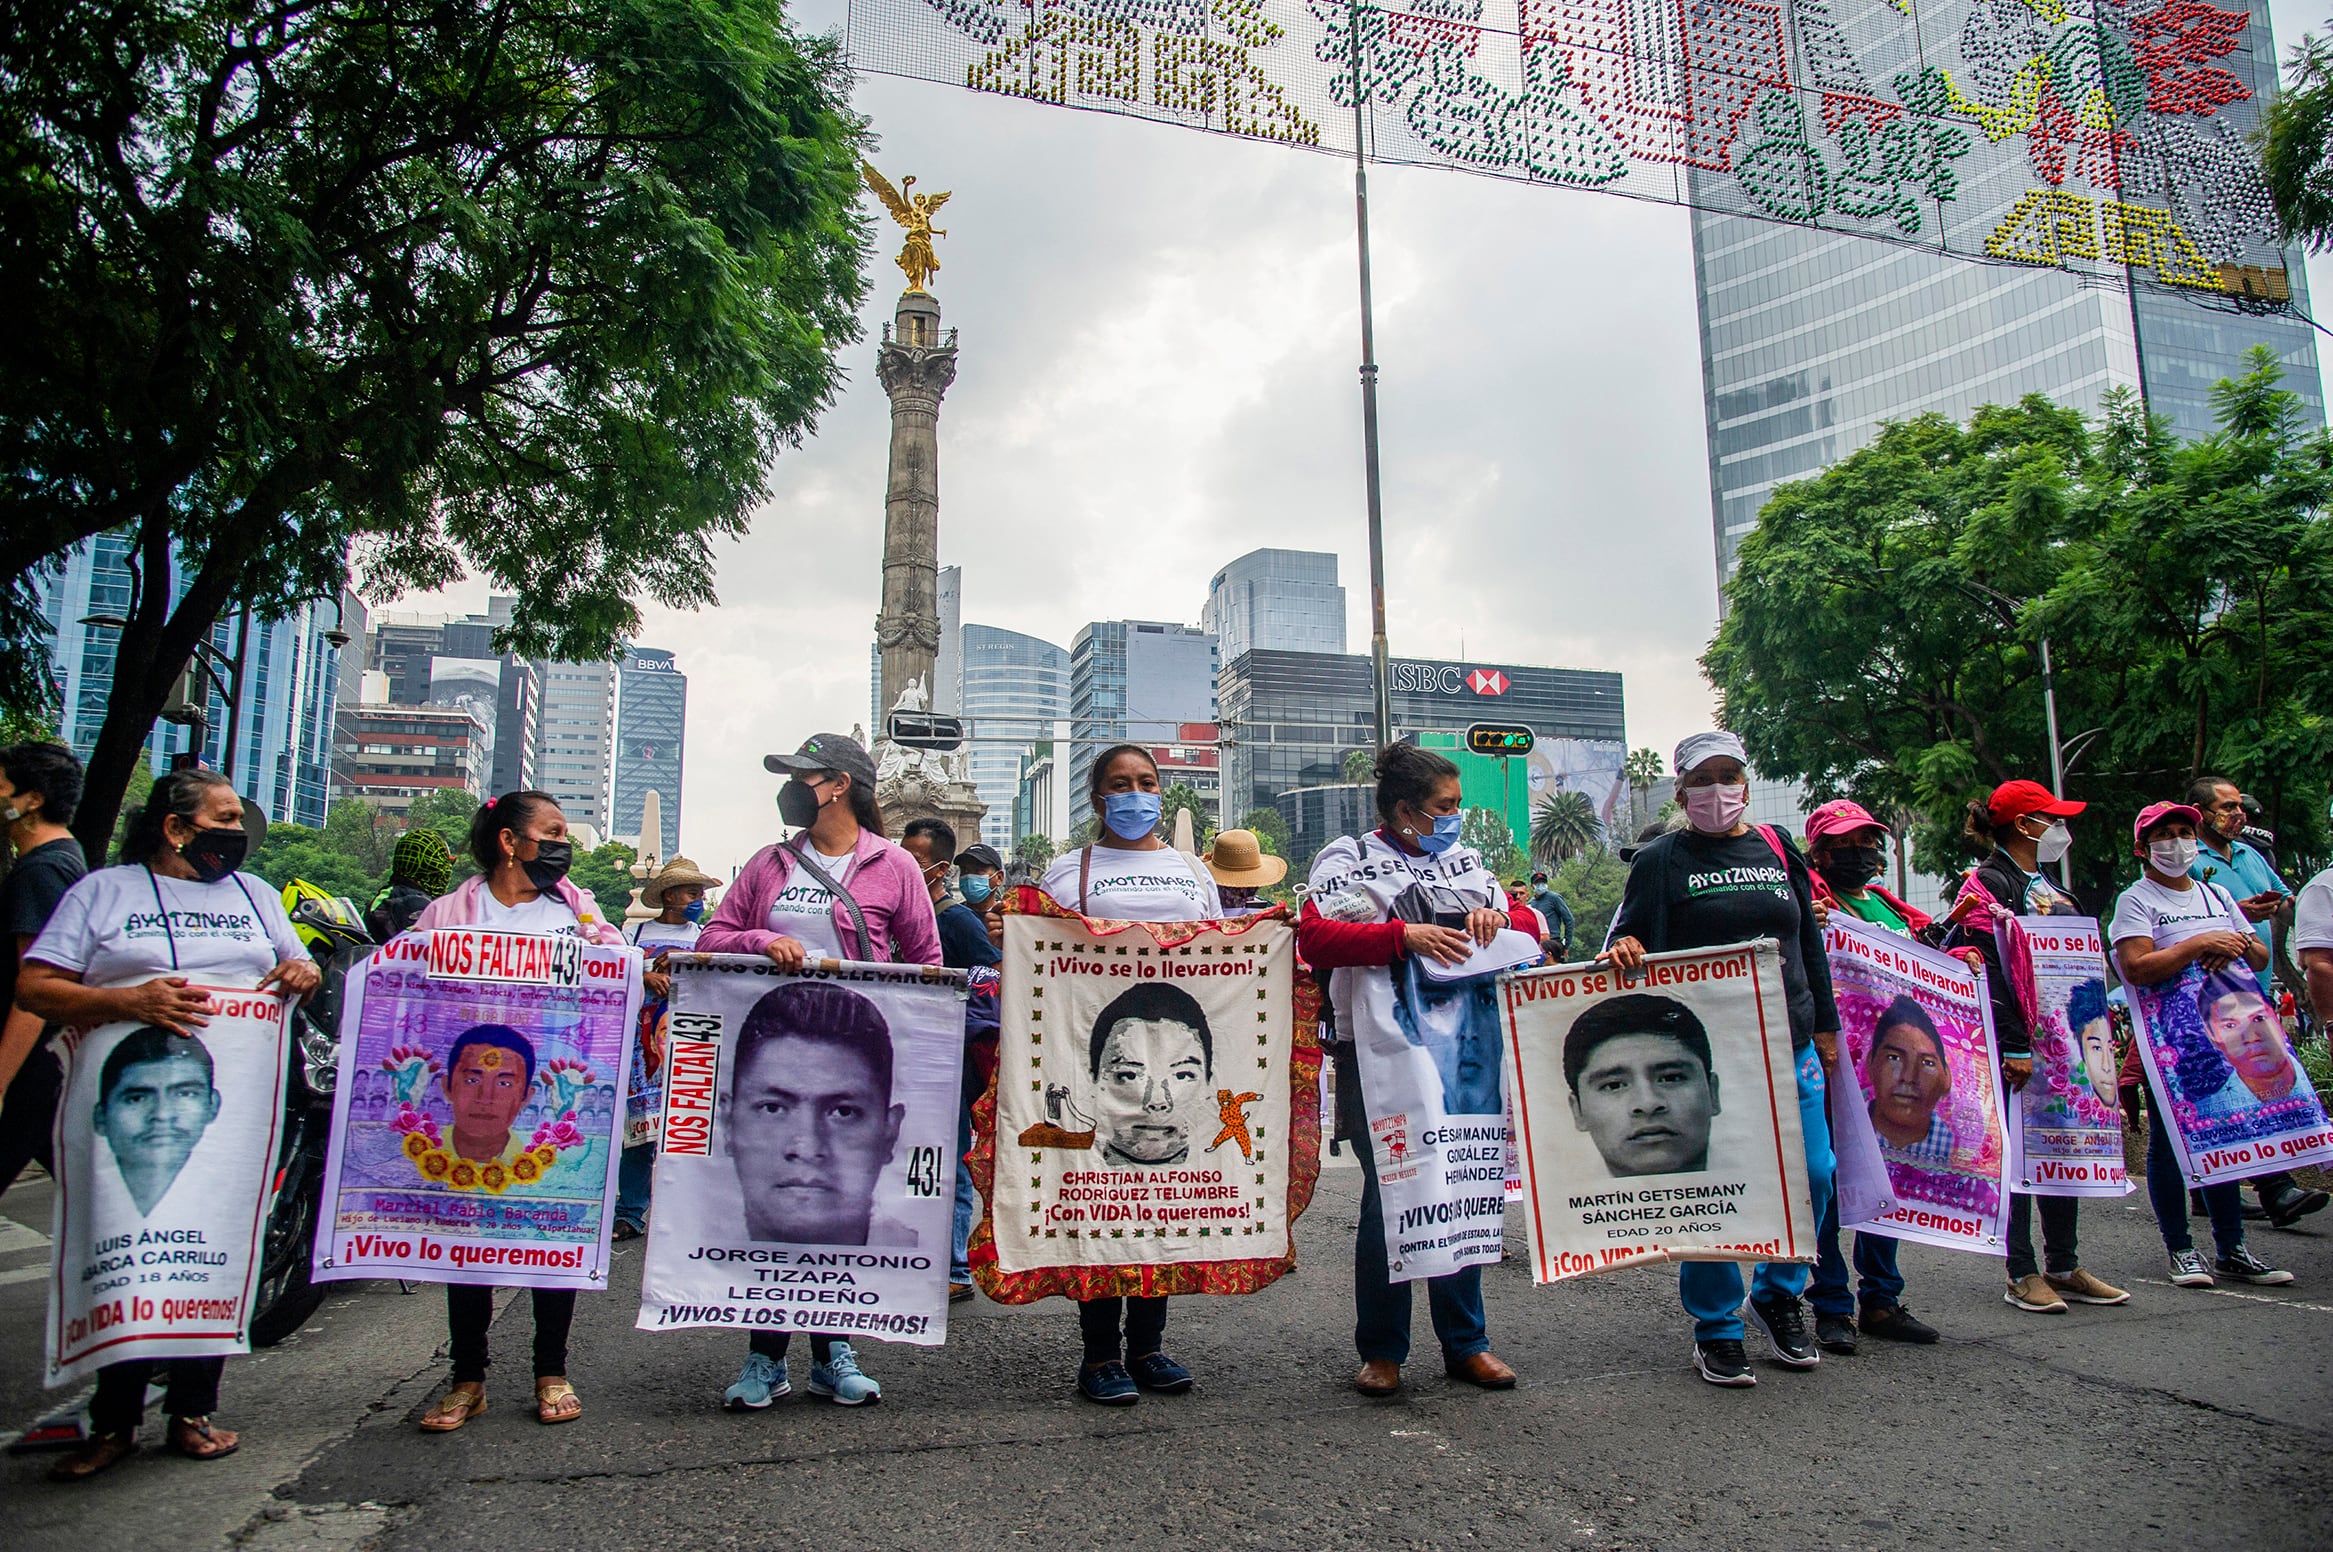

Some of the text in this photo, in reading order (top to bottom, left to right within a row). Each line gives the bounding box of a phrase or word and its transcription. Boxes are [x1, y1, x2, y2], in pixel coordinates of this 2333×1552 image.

[638, 659, 672, 670] BBVA
[1412, 867, 1437, 882] OS
[1740, 883, 1755, 891] con
[1774, 888, 1789, 900] 43
[127, 929, 185, 938] Caminado
[2064, 937, 2084, 951] se
[2088, 934, 2100, 953] lo
[429, 932, 583, 986] NOS FALTAN 43!
[1050, 957, 1253, 978] ¡Vivo se lo llevaron!
[1826, 929, 1870, 958] ¡Vivo
[1874, 948, 1891, 967] se
[1894, 953, 1908, 974] lo
[1912, 960, 1976, 999] llevaron!
[1514, 977, 1576, 1006] ¡Vivo
[1583, 974, 1607, 995] se
[1645, 955, 1749, 987] llevaron!
[212, 997, 280, 1024] varon!
[397, 1013, 428, 1034] 43
[558, 1025, 588, 1047] 43
[666, 1012, 722, 1155] NOS FALTAN 43!
[2042, 1135, 2077, 1145] JORGE
[2190, 1123, 2245, 1143] GIOVANNI
[2202, 1150, 2252, 1174] ¡Vivo
[2254, 1143, 2276, 1159] lo
[907, 1146, 942, 1197] 43!
[1063, 1170, 1222, 1184] CHRISTIAN ALFONSO
[2036, 1162, 2088, 1183] ¡Vivo
[2094, 1163, 2107, 1180] lo
[1059, 1186, 1239, 1200] RODRÍGUEZ TELUMBRE
[1569, 1183, 1747, 1208] MARTÍN GETSEMANY
[341, 1214, 363, 1224] Hijo
[384, 1215, 421, 1224] Luciano
[374, 1199, 568, 1221] Marcial Pablo Baranda
[1045, 1202, 1250, 1225] ¡Con VIDA lo queremos!
[1582, 1201, 1737, 1225] SÁNCHEZ GARCÍA
[1607, 1222, 1722, 1239] EDAD 20 AÑOS
[1874, 1207, 1983, 1237] ueremos!
[95, 1228, 207, 1255] LUIS ÁNGEL
[345, 1235, 584, 1268] ¡Vivo lo queremos!
[1400, 1239, 1435, 1255] CONTRA
[141, 1250, 228, 1266] CARRILLO
[689, 1247, 932, 1270] JORGE ANTONIO
[1553, 1252, 1595, 1277] ¡Con
[140, 1272, 161, 1283] 18
[168, 1269, 210, 1282] AÑOS
[754, 1269, 856, 1285] TIZAPA
[728, 1286, 880, 1305] LEGIDEÑO
[132, 1295, 154, 1322] lo
[162, 1296, 238, 1325] queremos!
[658, 1305, 929, 1335] ¡VIVOS LOS QUEREMOS!
